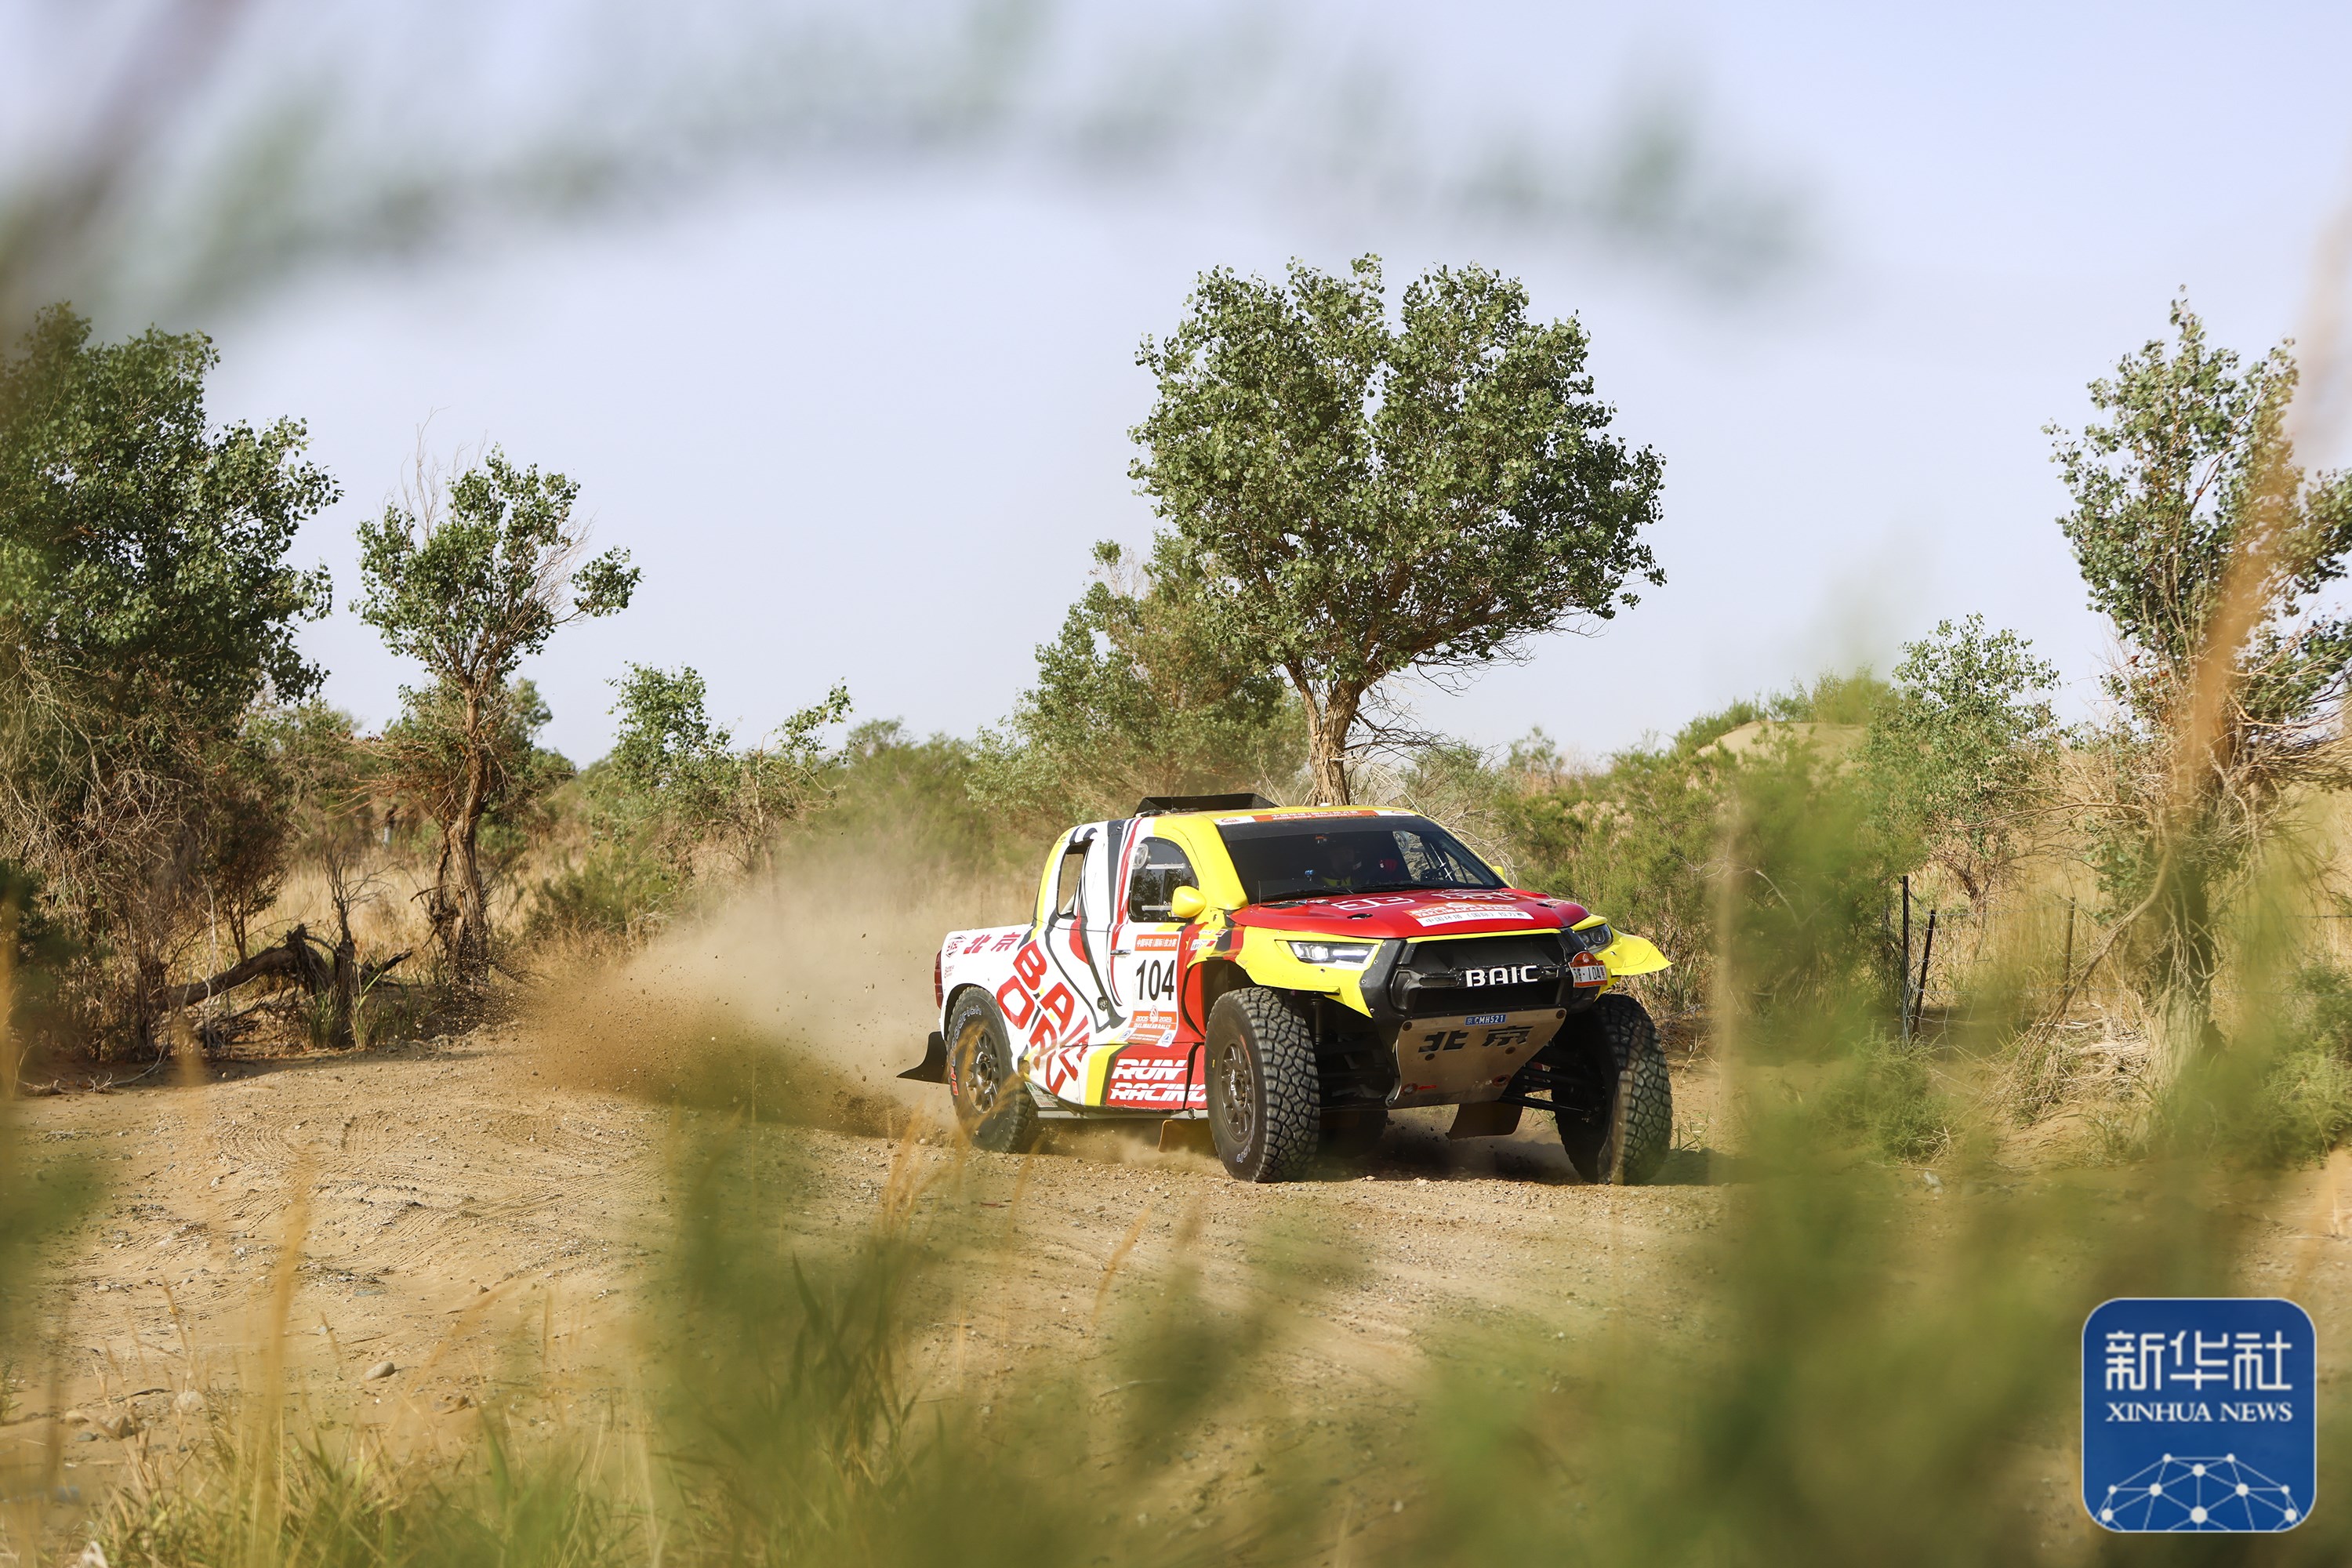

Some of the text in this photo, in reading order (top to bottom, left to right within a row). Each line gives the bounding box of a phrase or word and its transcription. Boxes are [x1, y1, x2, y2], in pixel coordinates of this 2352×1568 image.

[1414, 907, 1484, 918] TAKLIMAKAN
[963, 932, 1022, 955] 北京
[1136, 959, 1176, 1001] 104
[1465, 965, 1538, 988] BAIC
[1588, 966, 1602, 981] 104
[1418, 1025, 1534, 1054] 北京
[1112, 1058, 1189, 1080] RUN
